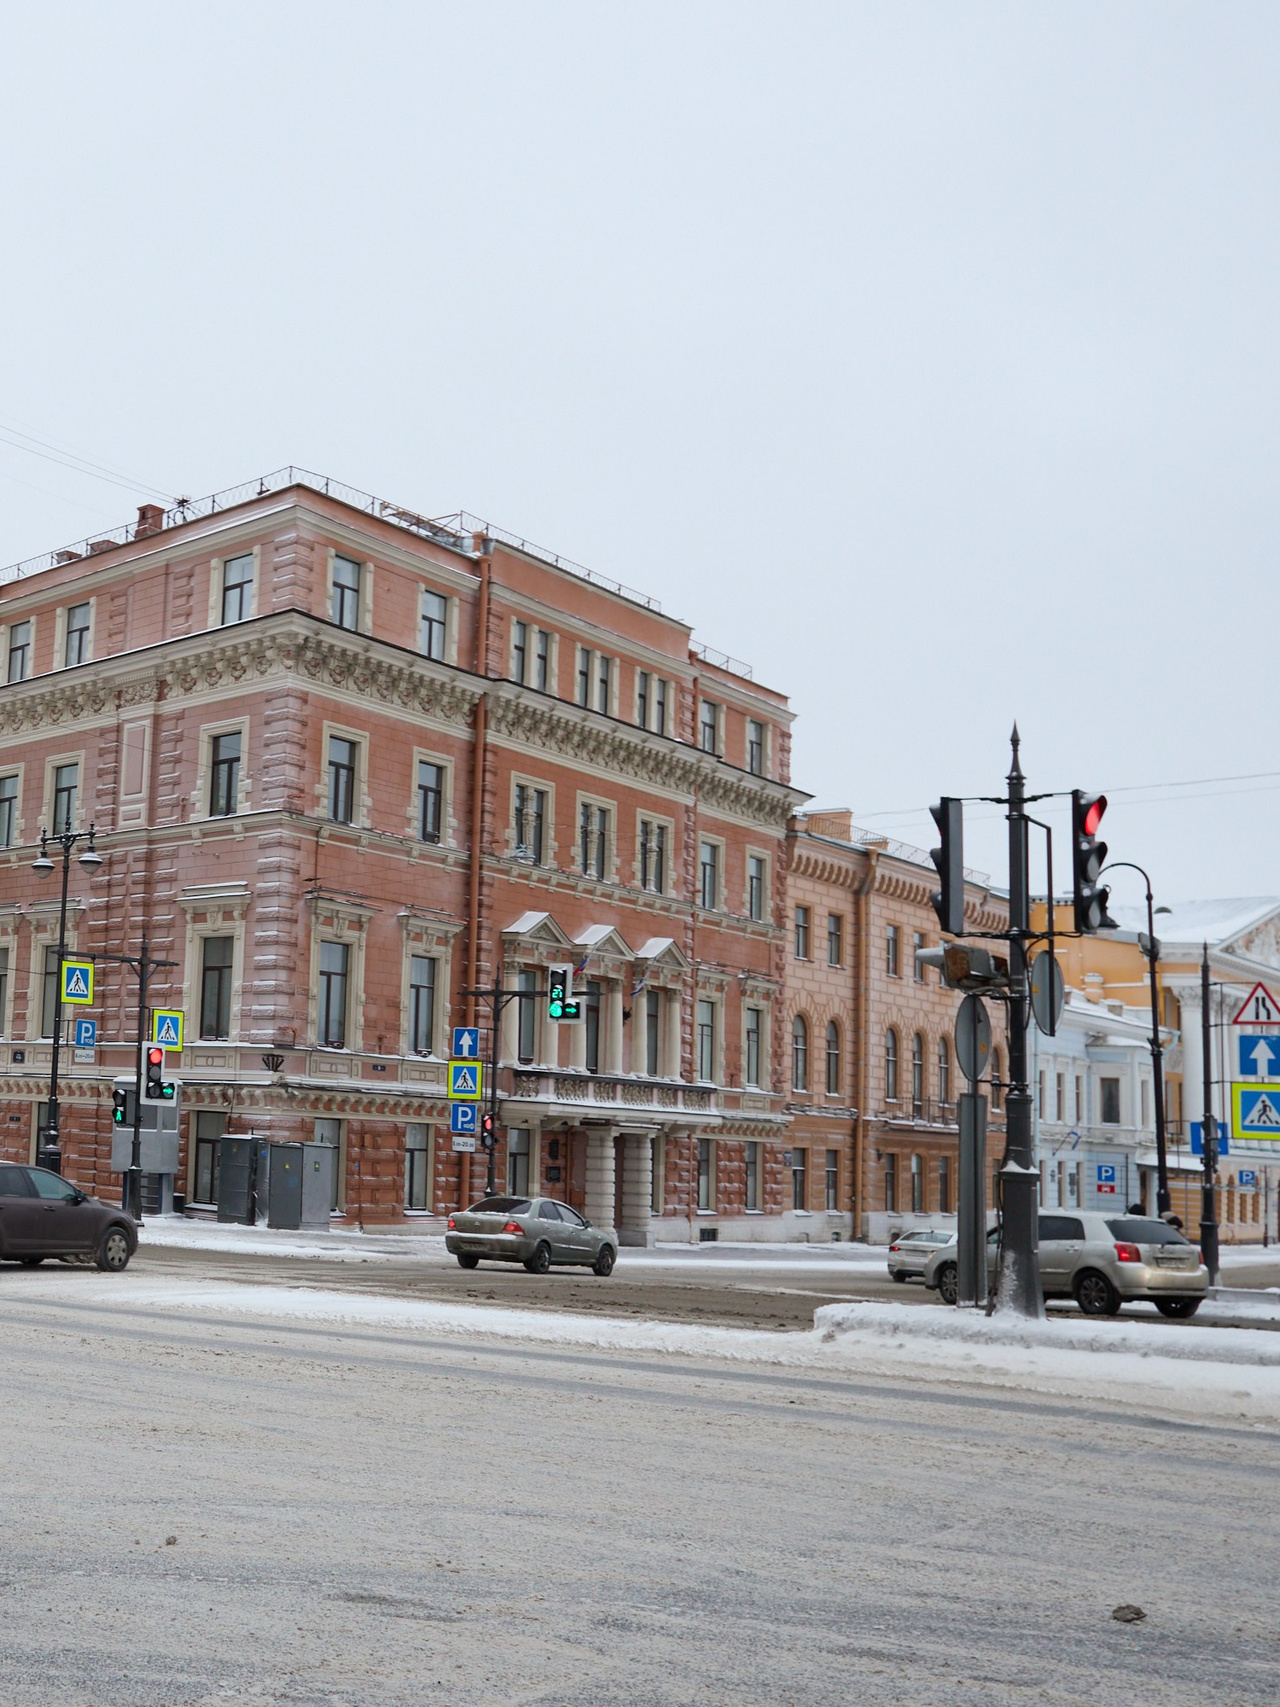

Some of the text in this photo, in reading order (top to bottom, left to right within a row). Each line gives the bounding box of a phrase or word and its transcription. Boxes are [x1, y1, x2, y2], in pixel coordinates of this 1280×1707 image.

[81, 1023, 92, 1044] P
[458, 1106, 472, 1129] P
[1101, 1167, 1112, 1180] P
[1242, 1172, 1253, 1183] P
